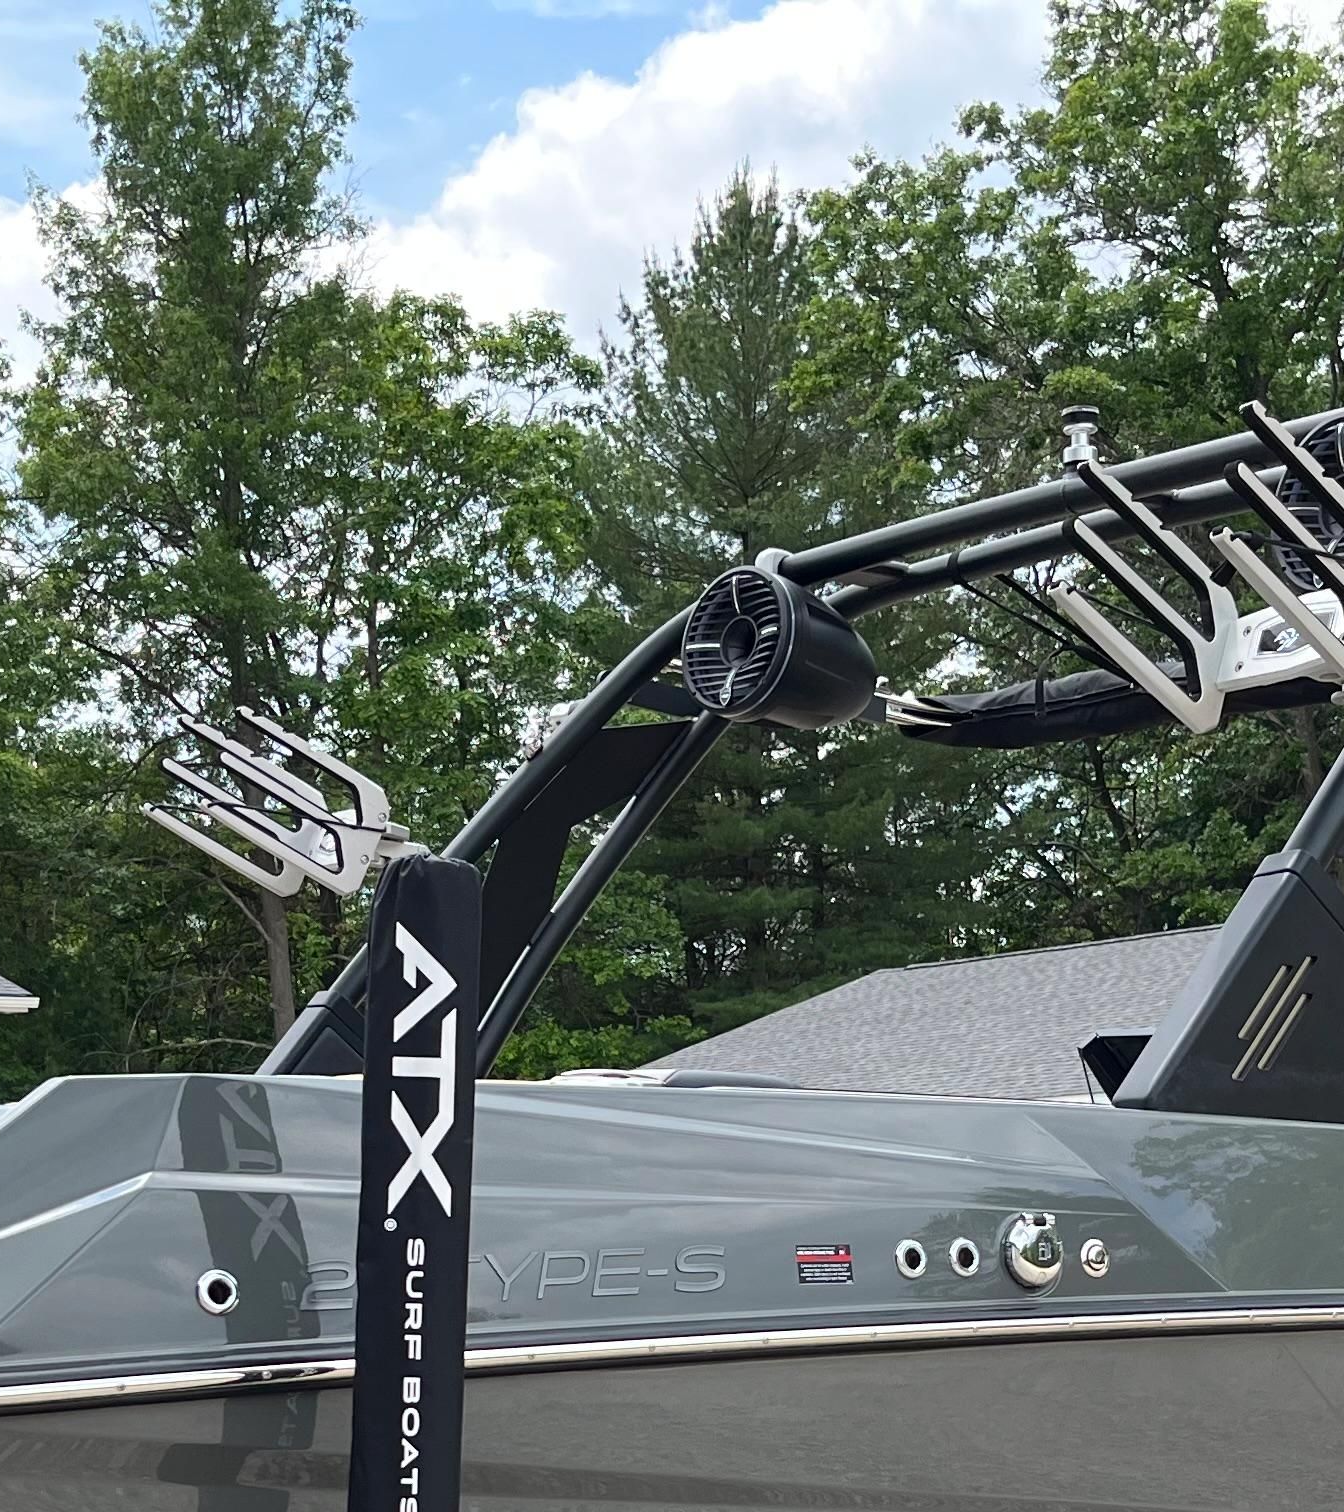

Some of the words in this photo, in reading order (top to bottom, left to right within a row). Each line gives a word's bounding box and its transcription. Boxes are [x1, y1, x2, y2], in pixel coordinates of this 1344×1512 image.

[388, 920, 458, 1218] ATX
[403, 1237, 425, 1361] SURF
[467, 1245, 726, 1301] YPE-S
